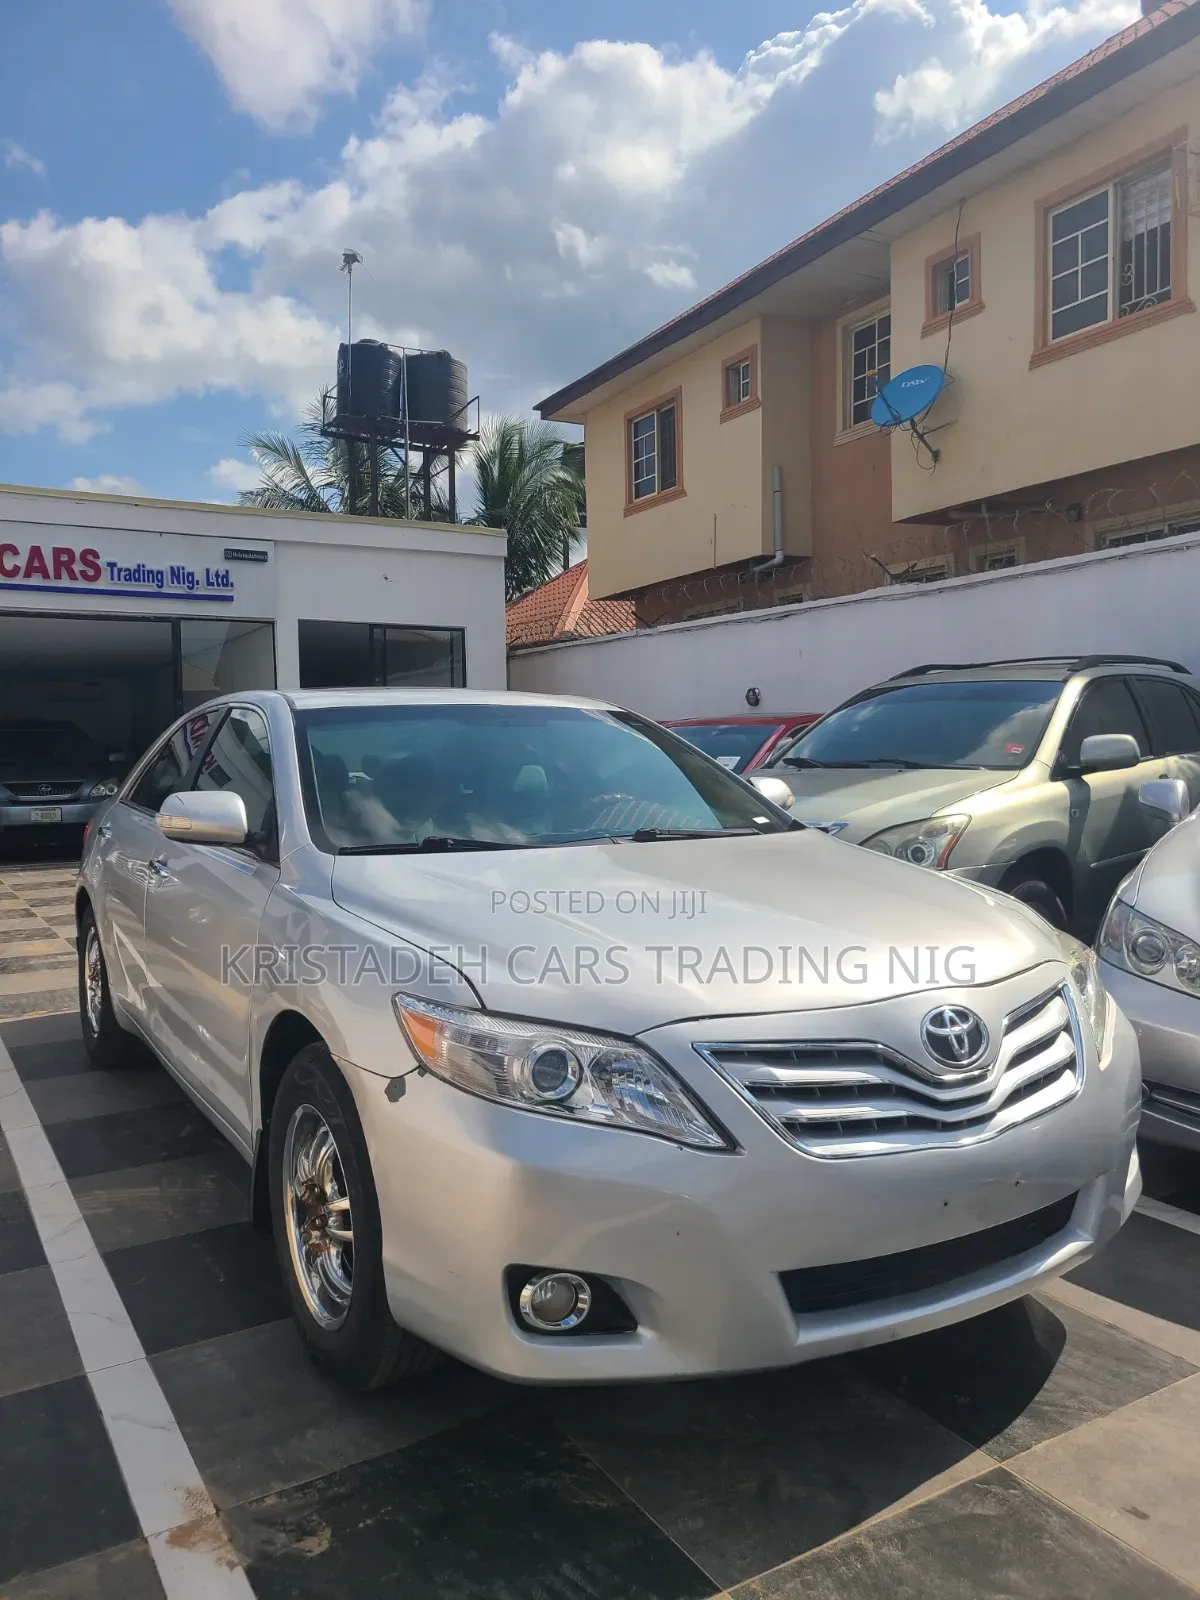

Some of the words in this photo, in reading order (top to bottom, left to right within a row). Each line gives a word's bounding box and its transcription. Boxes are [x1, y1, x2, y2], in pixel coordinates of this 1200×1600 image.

[0, 543, 102, 582] CARS
[106, 561, 164, 589] Trading
[169, 565, 200, 591] Nig.
[205, 568, 235, 588] Ltd.
